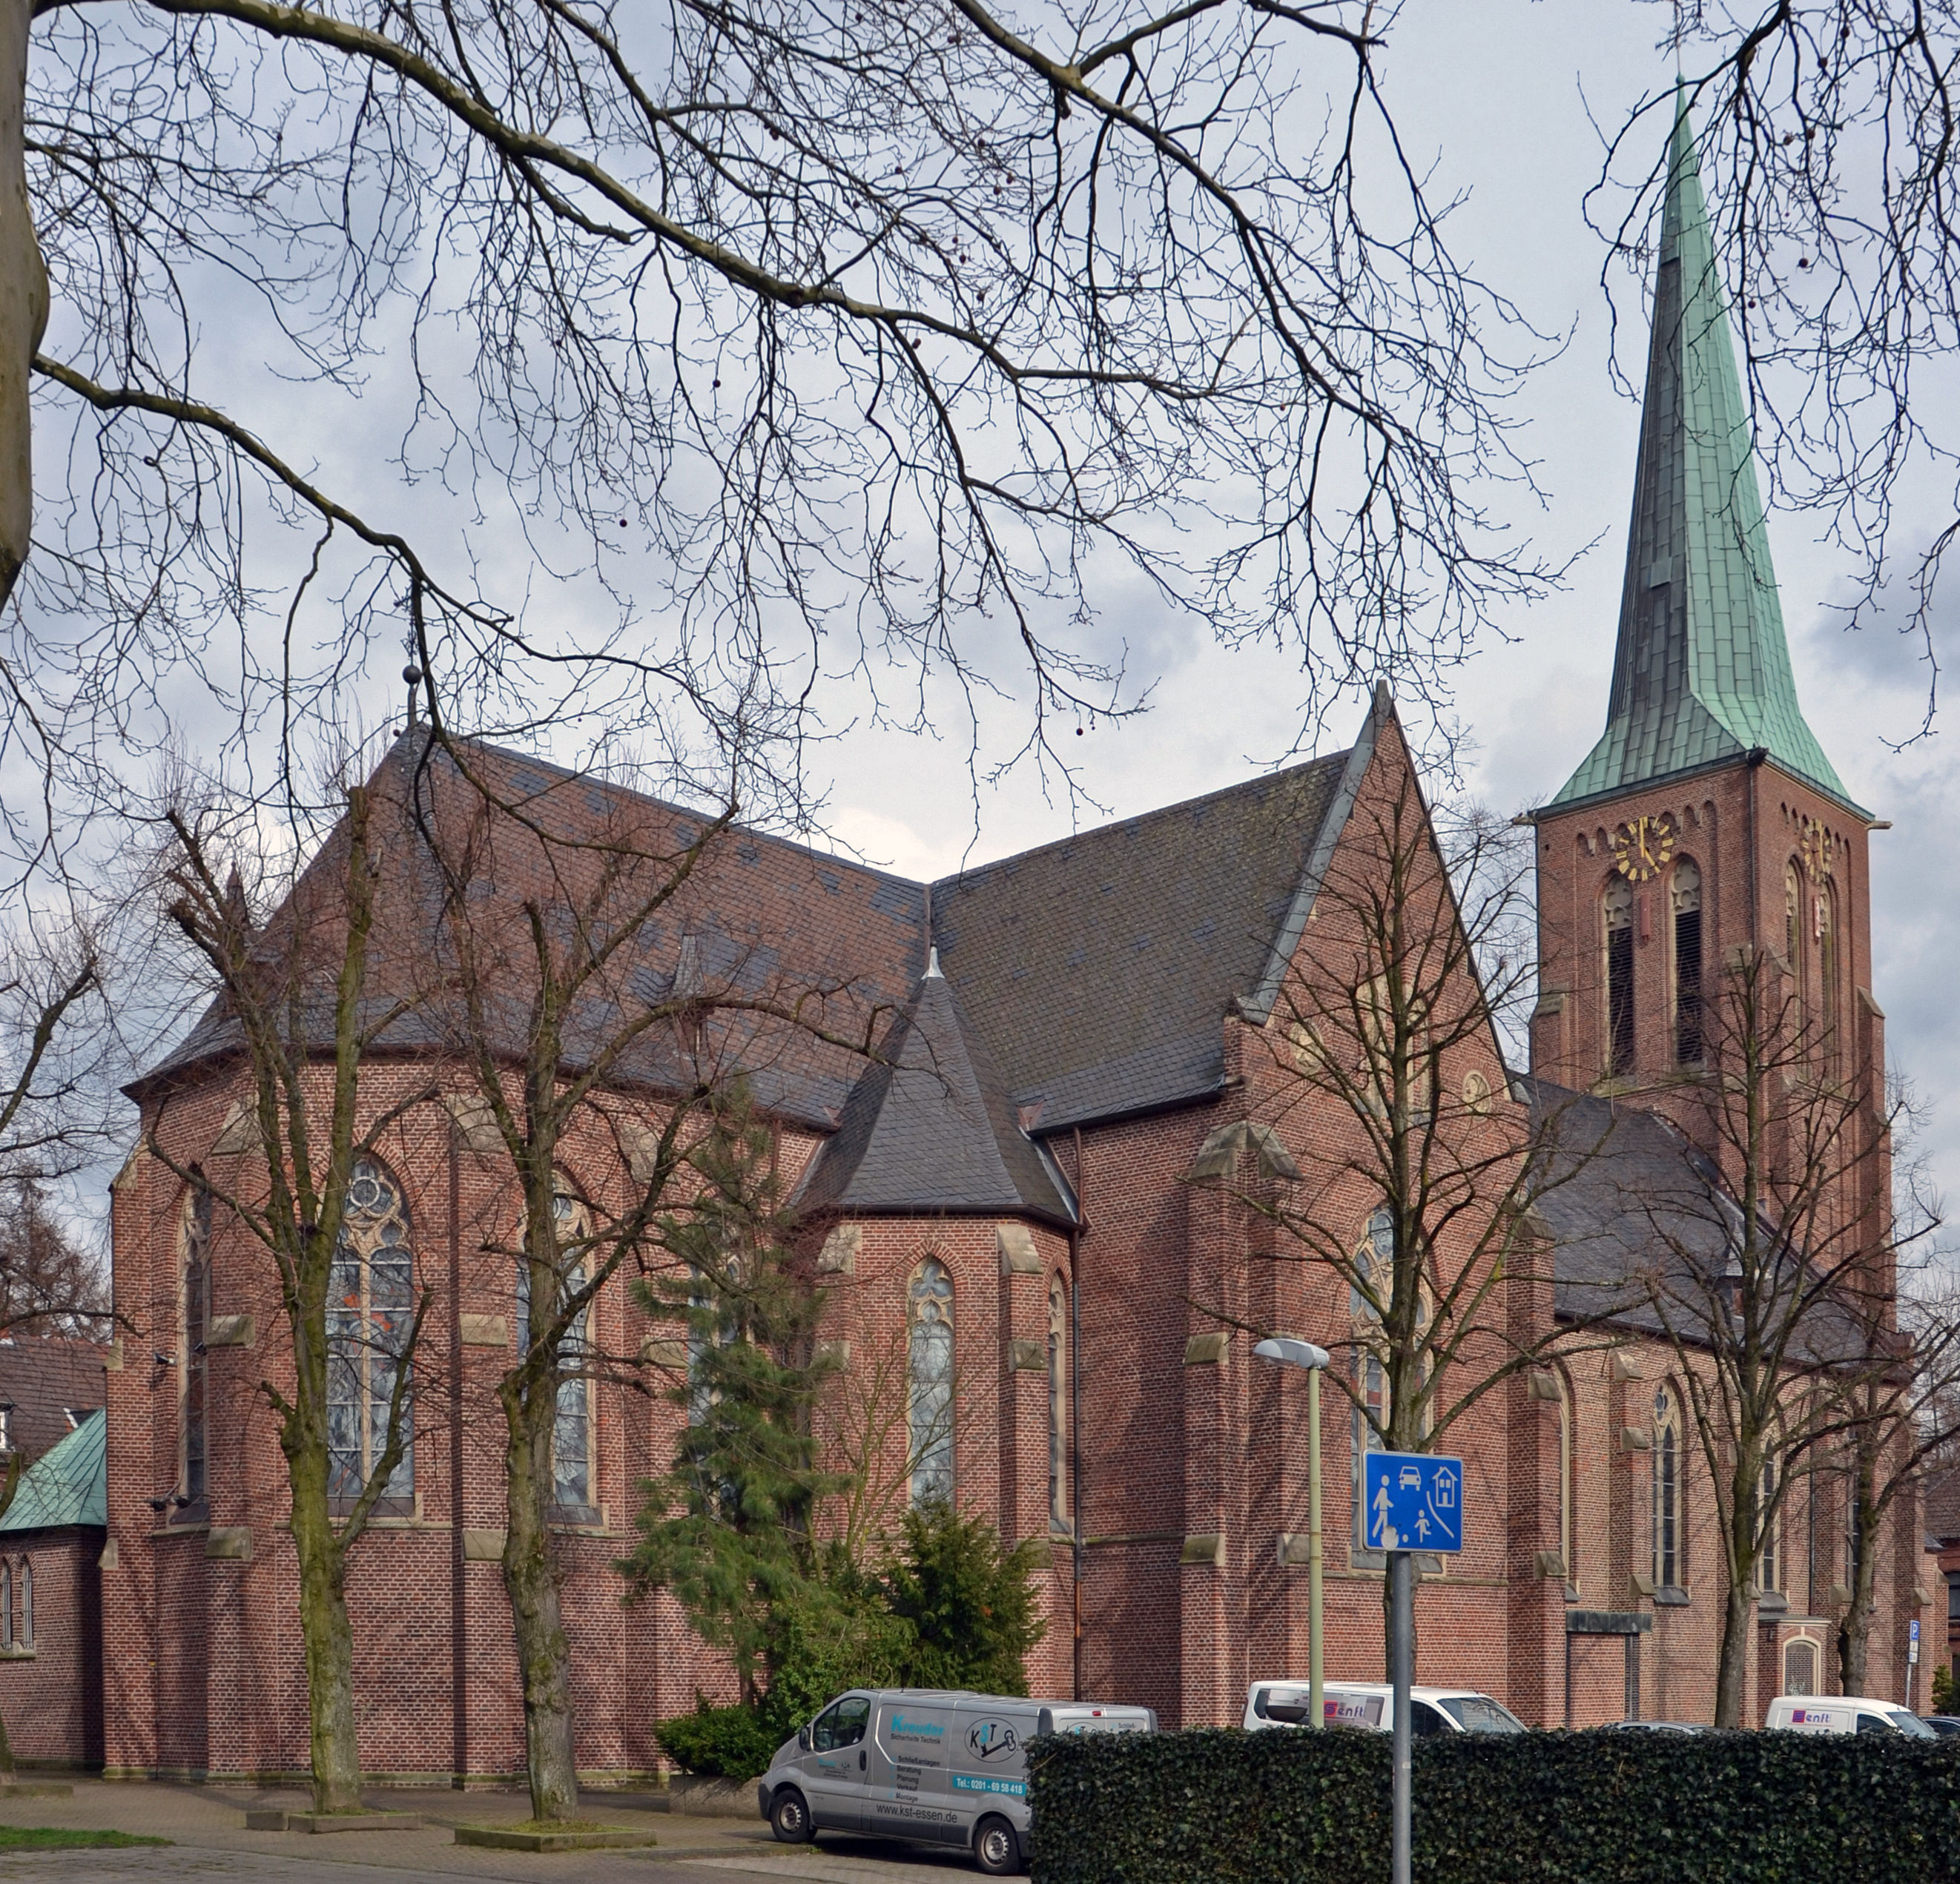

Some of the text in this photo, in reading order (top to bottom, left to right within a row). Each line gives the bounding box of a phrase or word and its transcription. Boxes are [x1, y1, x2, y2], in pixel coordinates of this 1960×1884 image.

[891, 1714, 944, 1736] Kreuder
[970, 1724, 997, 1748] KST
[897, 1765, 922, 1776] Beratung
[897, 1774, 920, 1785] Planung
[897, 1783, 918, 1791] Verkauf
[971, 1779, 986, 1790] 0201
[991, 1782, 1000, 1791] 69
[1010, 1784, 1023, 1794] 418
[896, 1792, 919, 1803] Montage
[877, 1804, 957, 1823] www.kst-essen.de
